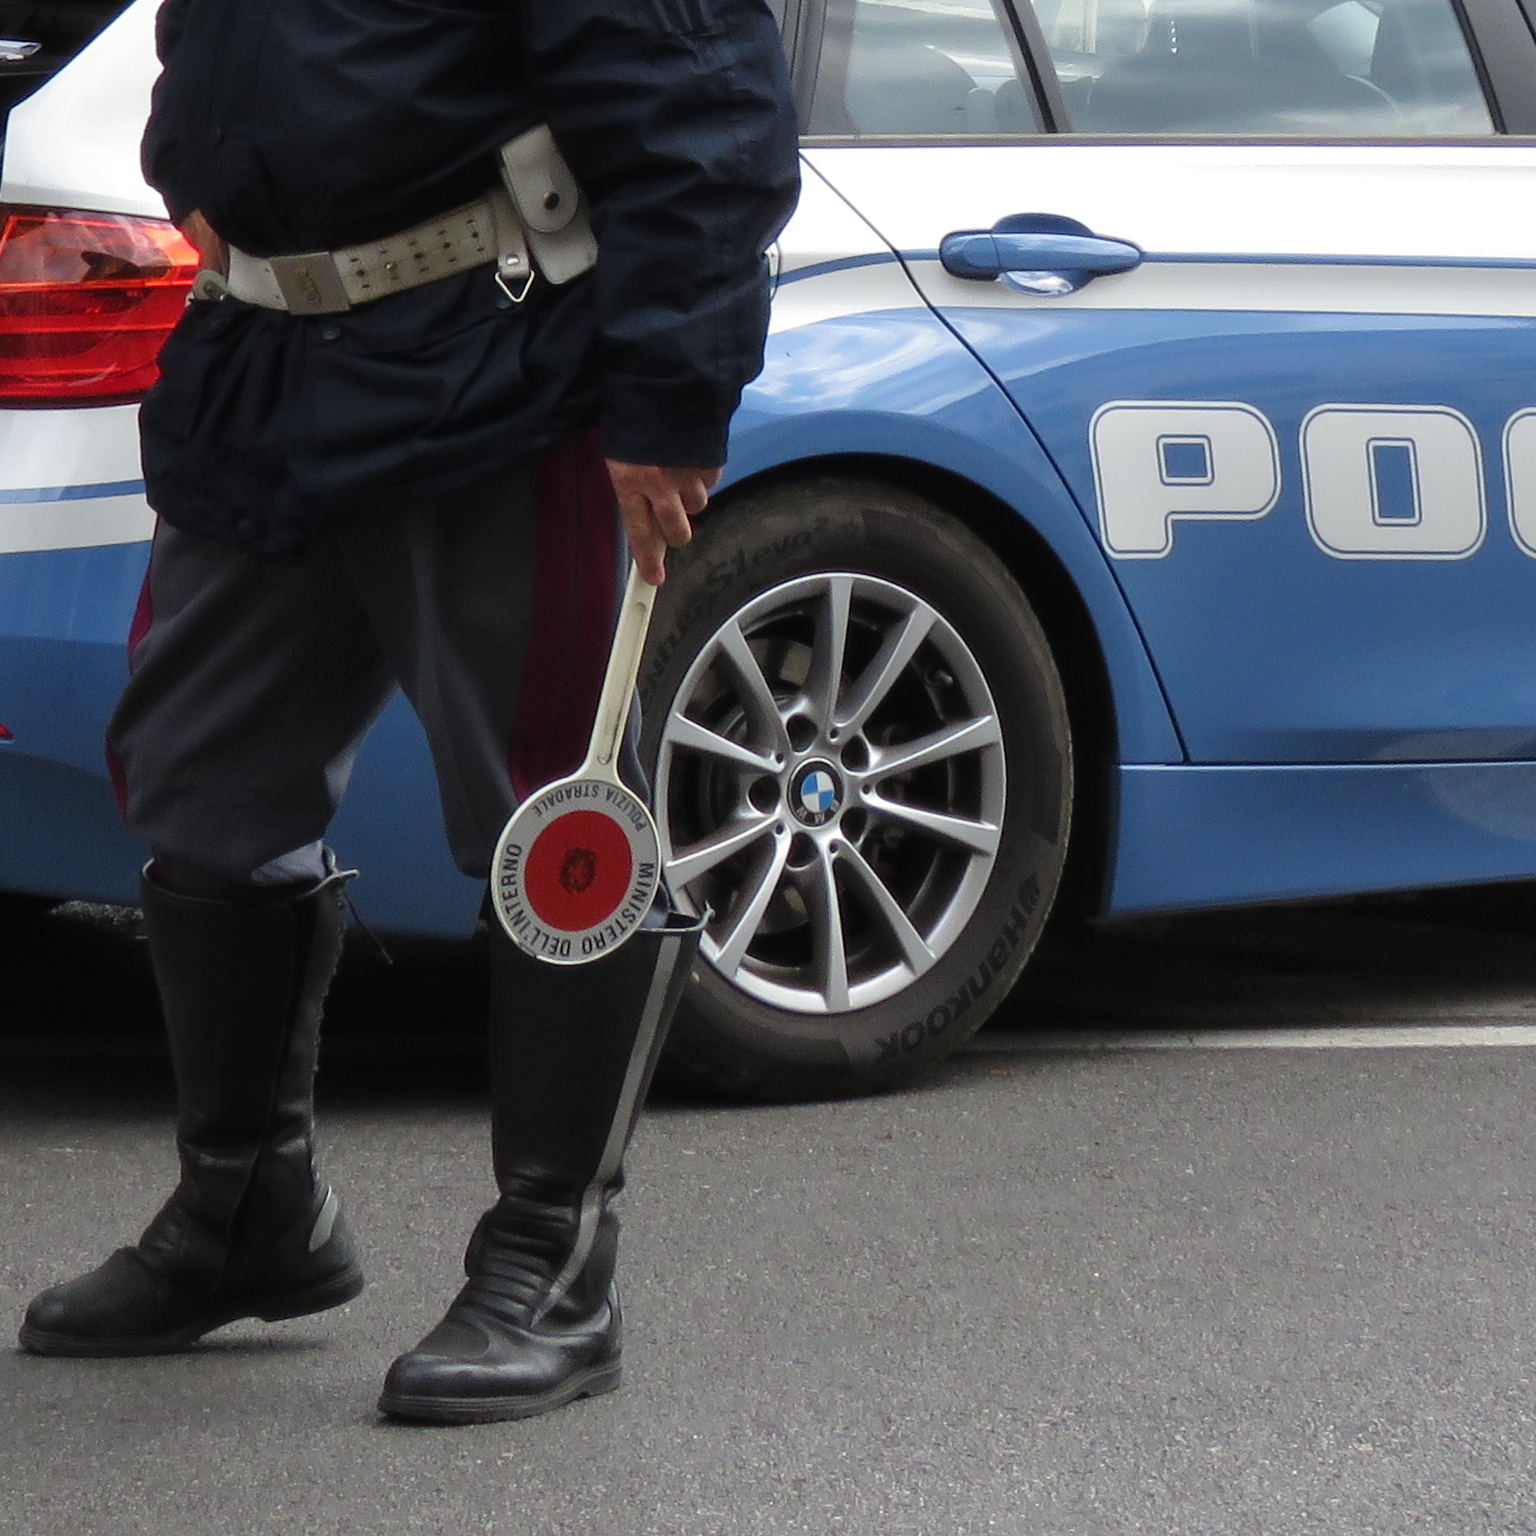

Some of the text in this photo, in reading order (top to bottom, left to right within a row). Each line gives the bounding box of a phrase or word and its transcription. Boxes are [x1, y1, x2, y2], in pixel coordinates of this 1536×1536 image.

[532, 784, 648, 832] POLIZIA STRADALE
[501, 843, 654, 957] MINISTERO DELL'INTERNO
